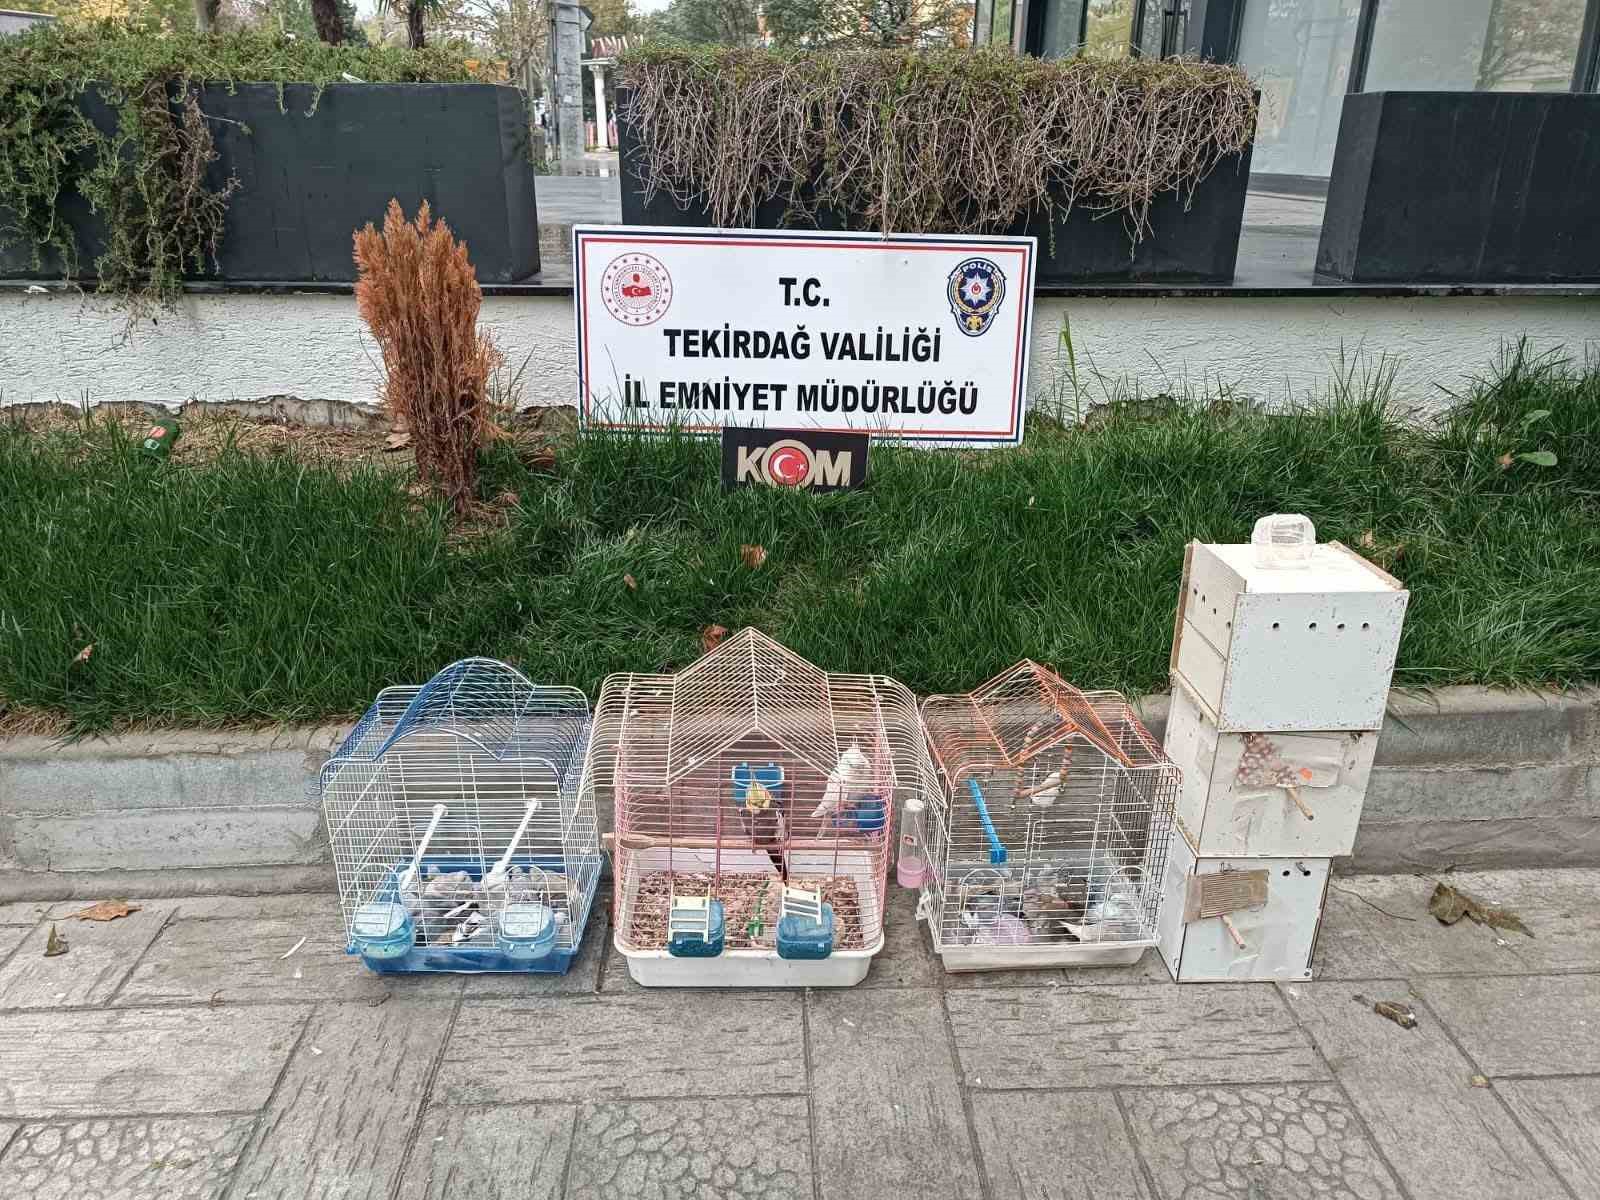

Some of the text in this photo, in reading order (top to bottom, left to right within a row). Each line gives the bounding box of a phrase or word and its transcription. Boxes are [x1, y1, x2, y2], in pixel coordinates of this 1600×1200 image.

[779, 277, 830, 307] T.C.
[663, 322, 941, 362] TEKİRDAĞ VALİLİĞİ
[624, 373, 978, 415] İL EMNİYET MÜDÜRLÜĞÜ
[737, 439, 852, 488] KOM
